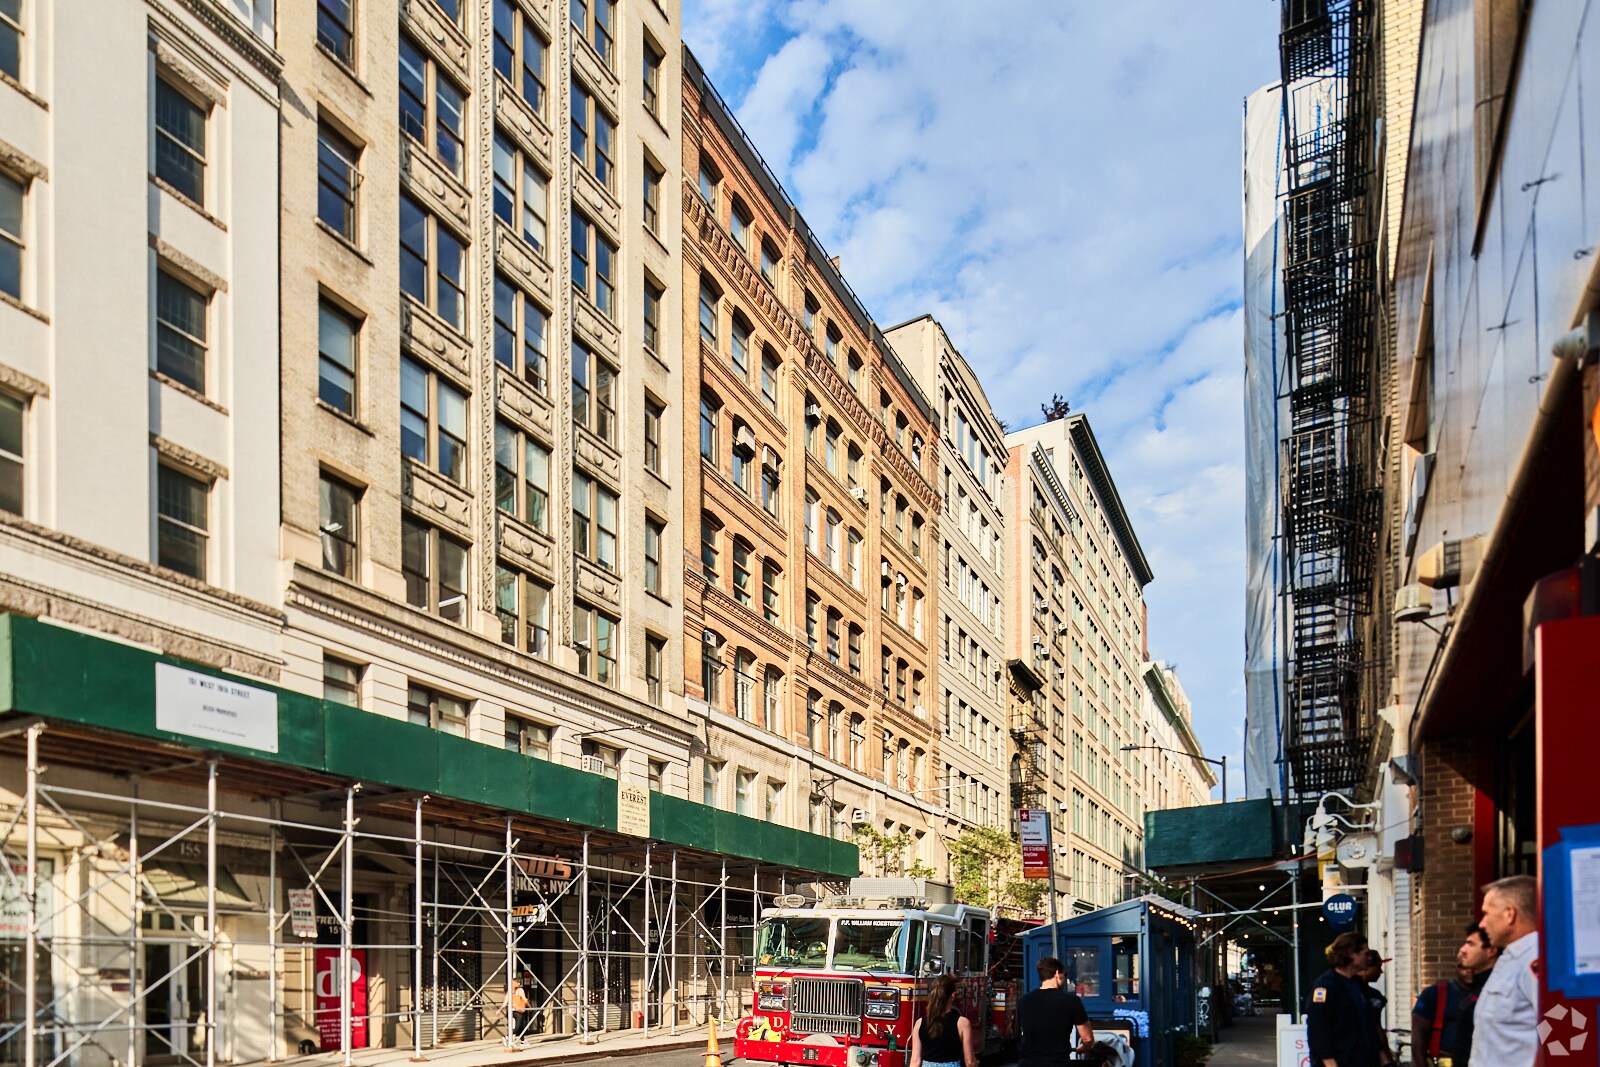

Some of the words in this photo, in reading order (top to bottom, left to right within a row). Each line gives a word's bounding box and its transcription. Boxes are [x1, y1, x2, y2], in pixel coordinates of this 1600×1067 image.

[621, 791, 647, 805] EVEREST
[180, 842, 201, 857] 155
[1328, 902, 1352, 911] GLUR
[727, 913, 738, 922] Asian
